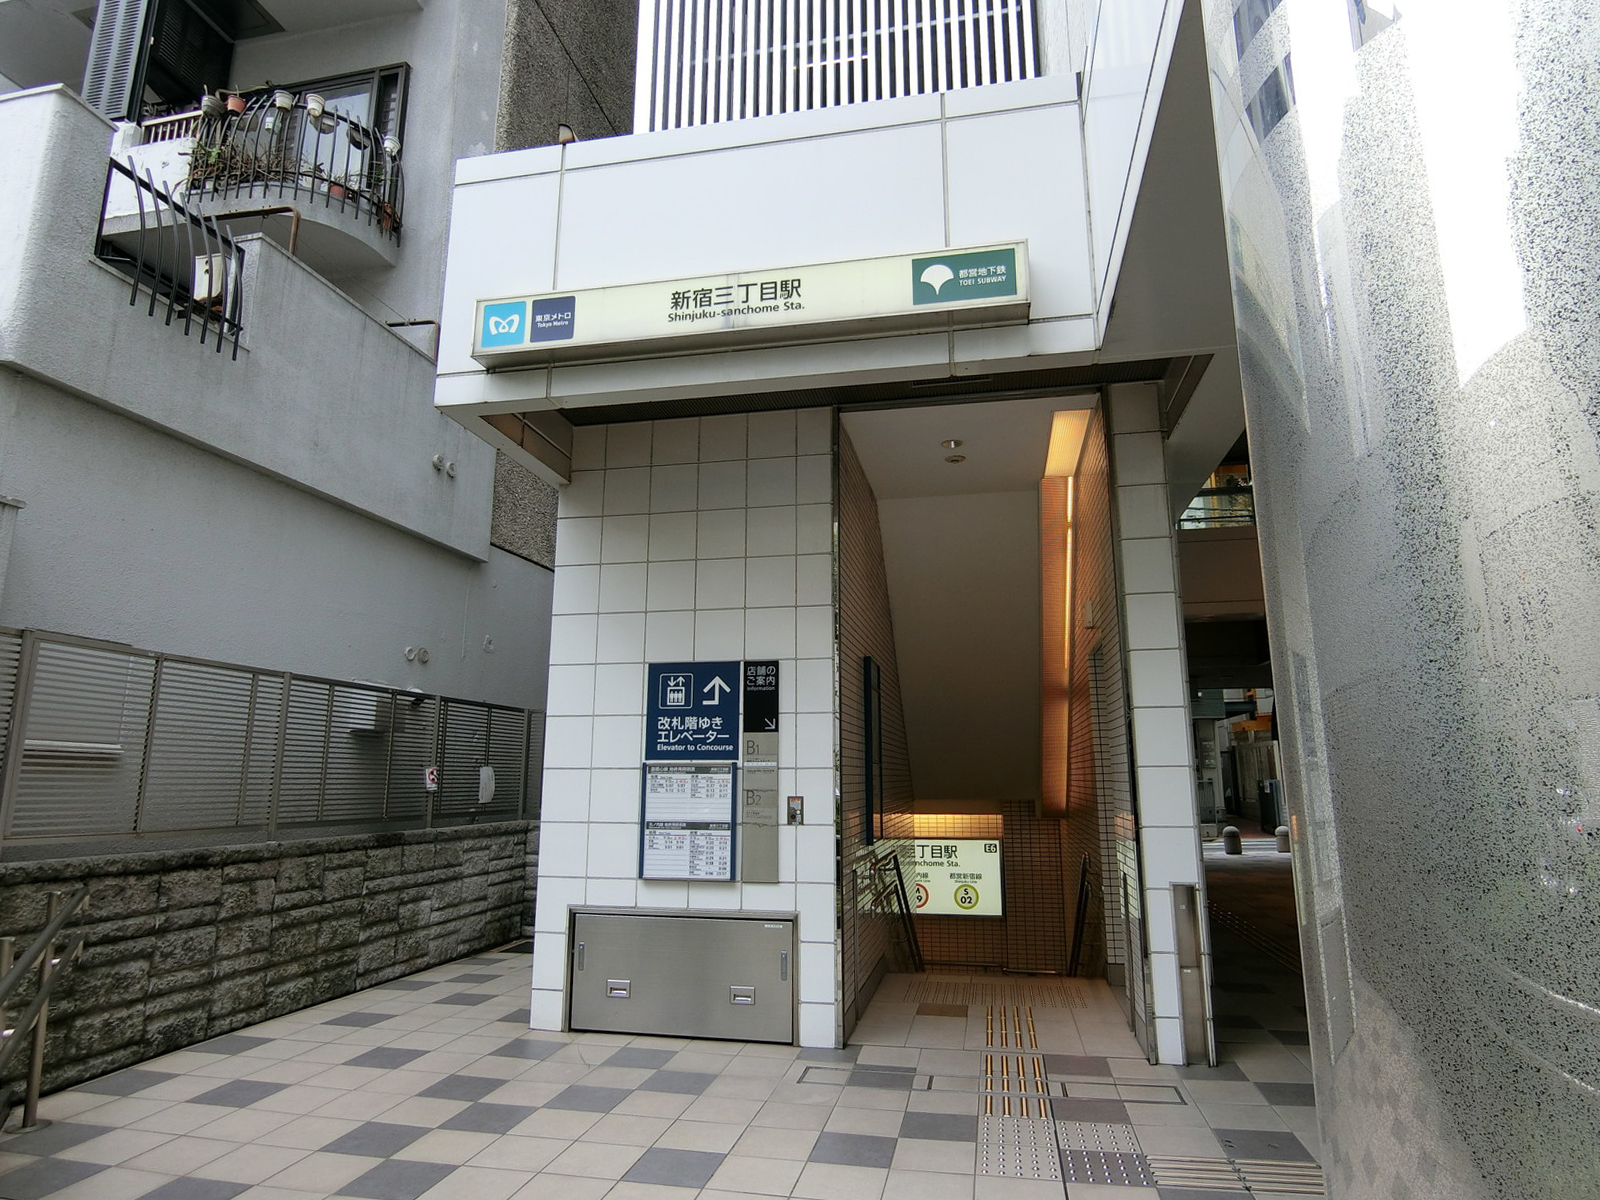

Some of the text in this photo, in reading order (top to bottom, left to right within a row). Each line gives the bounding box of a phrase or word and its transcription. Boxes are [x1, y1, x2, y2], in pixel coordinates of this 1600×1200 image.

[959, 265, 1006, 278] 都営地下鉄
[977, 276, 1007, 284] SUBWAY
[670, 278, 802, 311] 新宿三丁目駅
[535, 312, 571, 322] 東京メトロ
[668, 301, 805, 322] Shinjuku-sanchome Sta.
[747, 666, 776, 676] 店舗の
[747, 676, 776, 686] ご案内
[657, 716, 723, 730] 改札階ゆき
[657, 730, 730, 743] エレベーター
[746, 740, 760, 755] B1
[746, 789, 762, 805] B2
[985, 844, 997, 853] E6
[960, 896, 973, 904] 02
